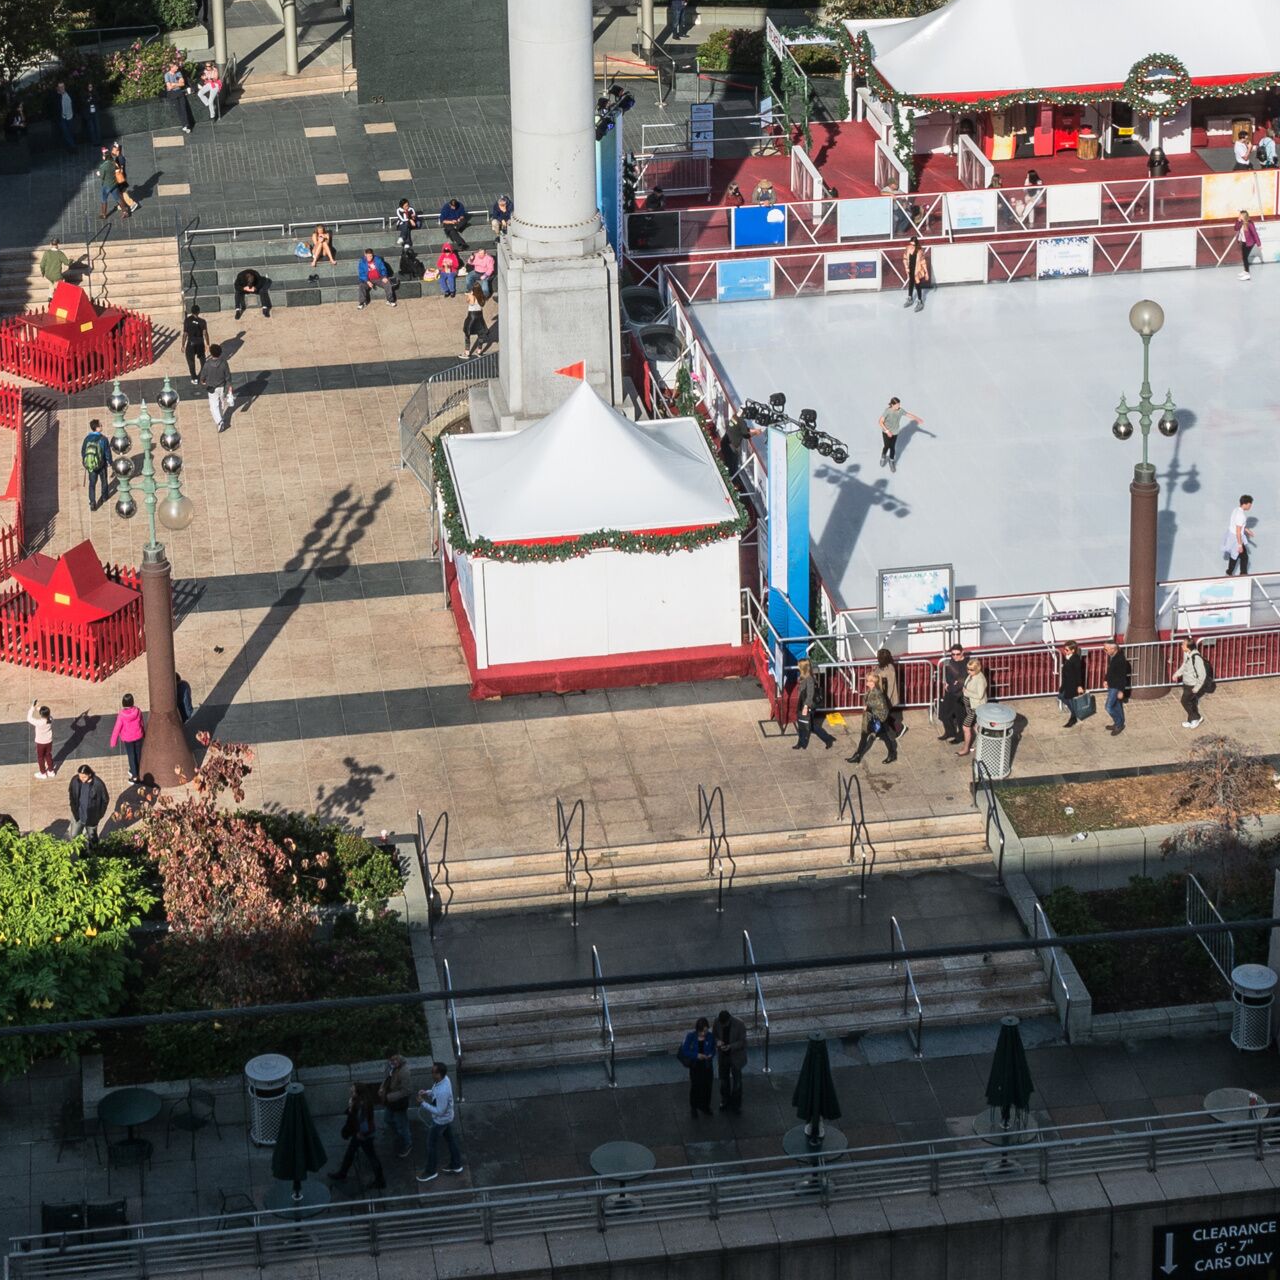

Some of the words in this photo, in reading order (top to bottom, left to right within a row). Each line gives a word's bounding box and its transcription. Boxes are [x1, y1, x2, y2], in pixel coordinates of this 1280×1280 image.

[1192, 1220, 1277, 1242] CLEARANCE
[1194, 1255, 1229, 1272] CARS
[1231, 1251, 1273, 1268] ONLY
